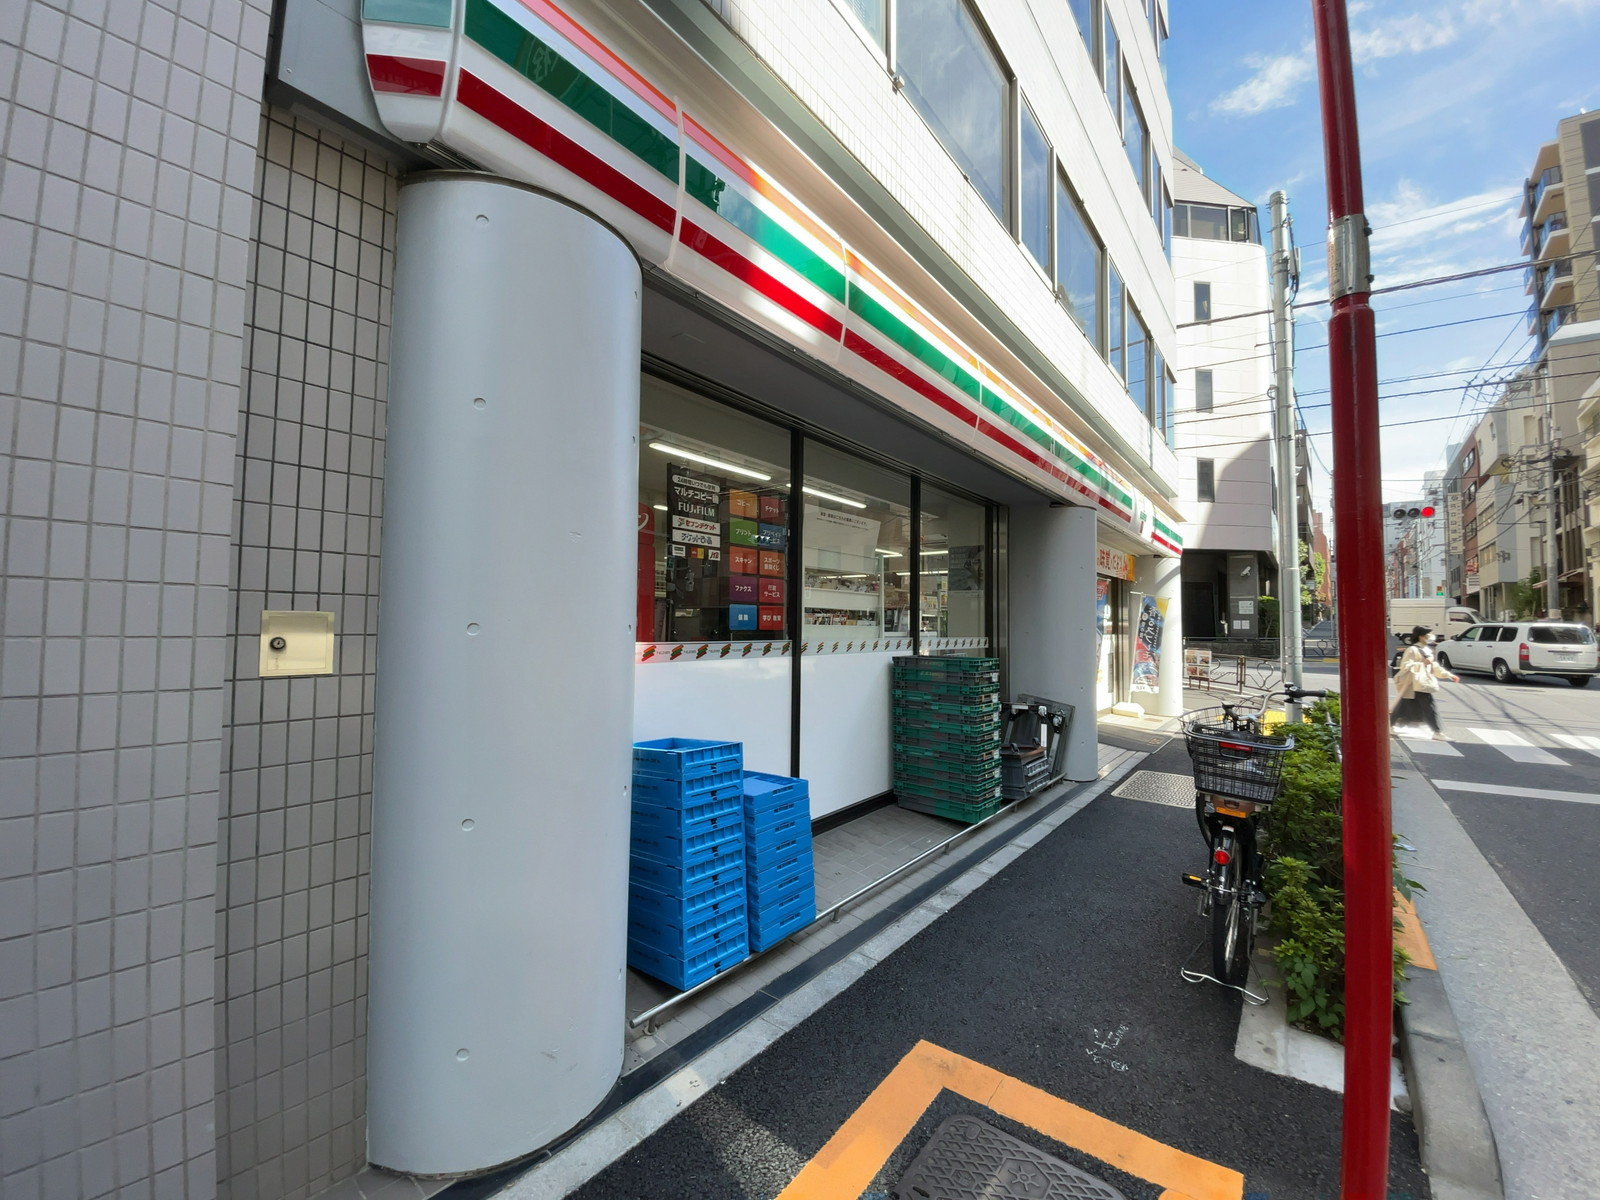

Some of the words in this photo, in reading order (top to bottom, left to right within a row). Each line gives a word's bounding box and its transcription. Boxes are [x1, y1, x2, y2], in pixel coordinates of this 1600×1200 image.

[678, 502, 715, 517] FUJIFILM
[765, 505, 779, 513] チケット
[685, 519, 717, 531] セブンチケット
[735, 528, 752, 536] プリント
[681, 532, 713, 545] チケットぴあ
[735, 556, 752, 564] スキャン
